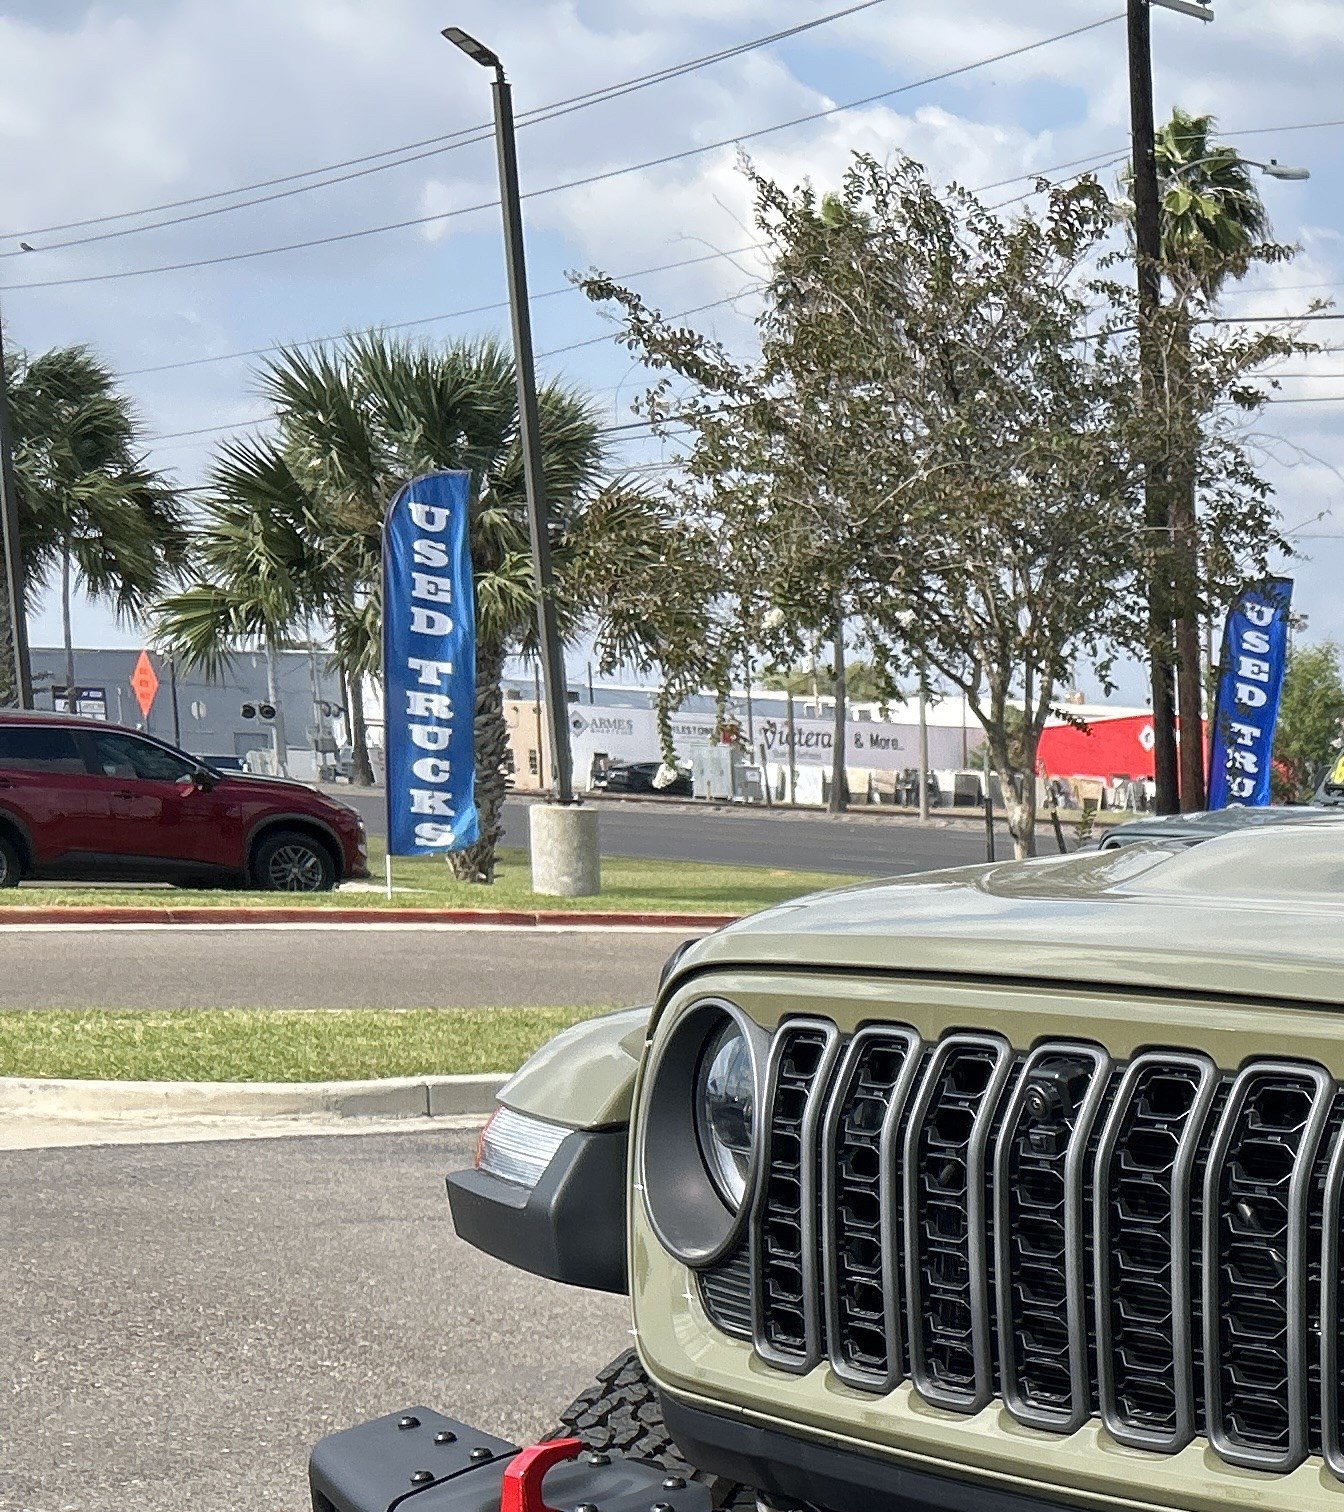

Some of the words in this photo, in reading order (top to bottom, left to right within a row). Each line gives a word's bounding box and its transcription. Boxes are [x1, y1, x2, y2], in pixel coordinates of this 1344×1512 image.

[408, 502, 453, 636] USED
[1234, 602, 1275, 708] USED
[406, 658, 455, 847] TRUCKS
[1226, 722, 1261, 809] TRU
